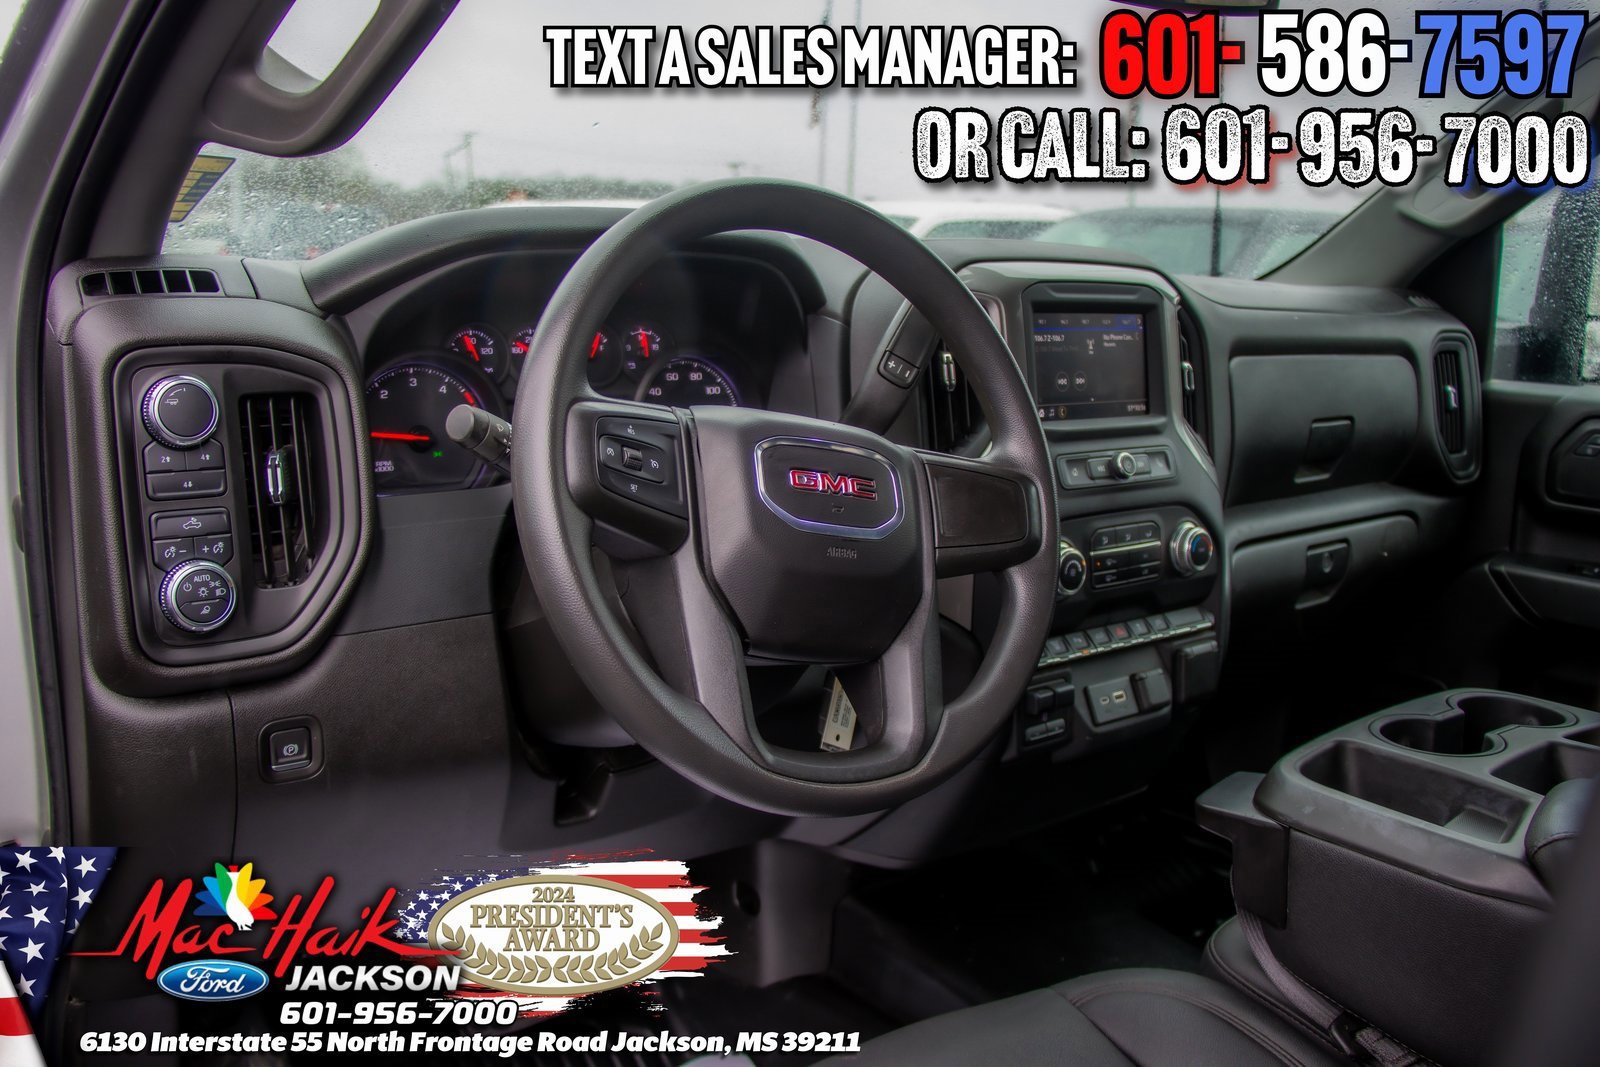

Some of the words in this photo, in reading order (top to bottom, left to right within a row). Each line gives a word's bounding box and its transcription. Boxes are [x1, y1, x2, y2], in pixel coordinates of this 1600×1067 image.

[409, 377, 417, 387] 3
[380, 389, 389, 399] 2
[438, 385, 447, 394] 4
[649, 387, 662, 396] 40
[789, 469, 878, 501] GMC
[193, 574, 211, 583] AUTO
